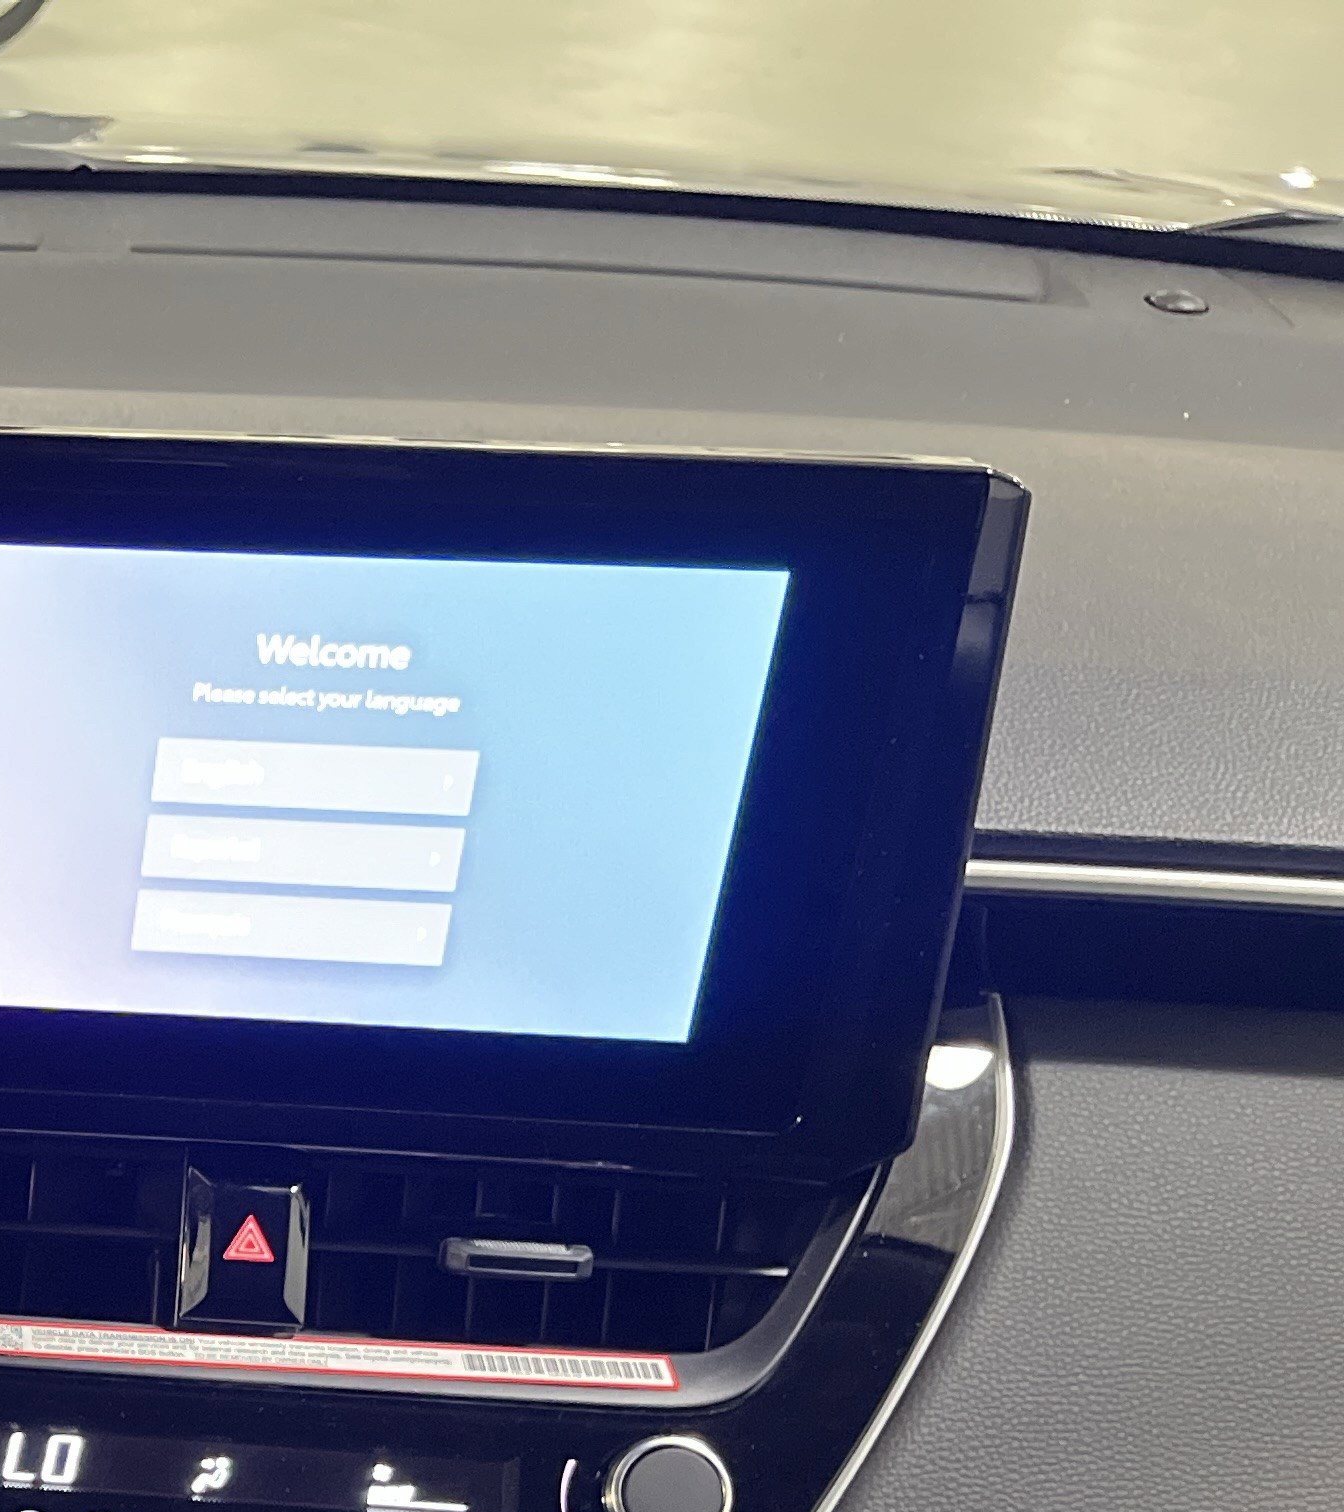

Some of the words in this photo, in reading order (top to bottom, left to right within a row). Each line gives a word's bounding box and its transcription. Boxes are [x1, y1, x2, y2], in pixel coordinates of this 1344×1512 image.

[256, 632, 411, 671] Welcome
[192, 681, 256, 705] Please
[258, 686, 315, 707] select
[317, 690, 363, 713] your
[364, 690, 461, 717] language
[1, 1431, 85, 1484] LO
